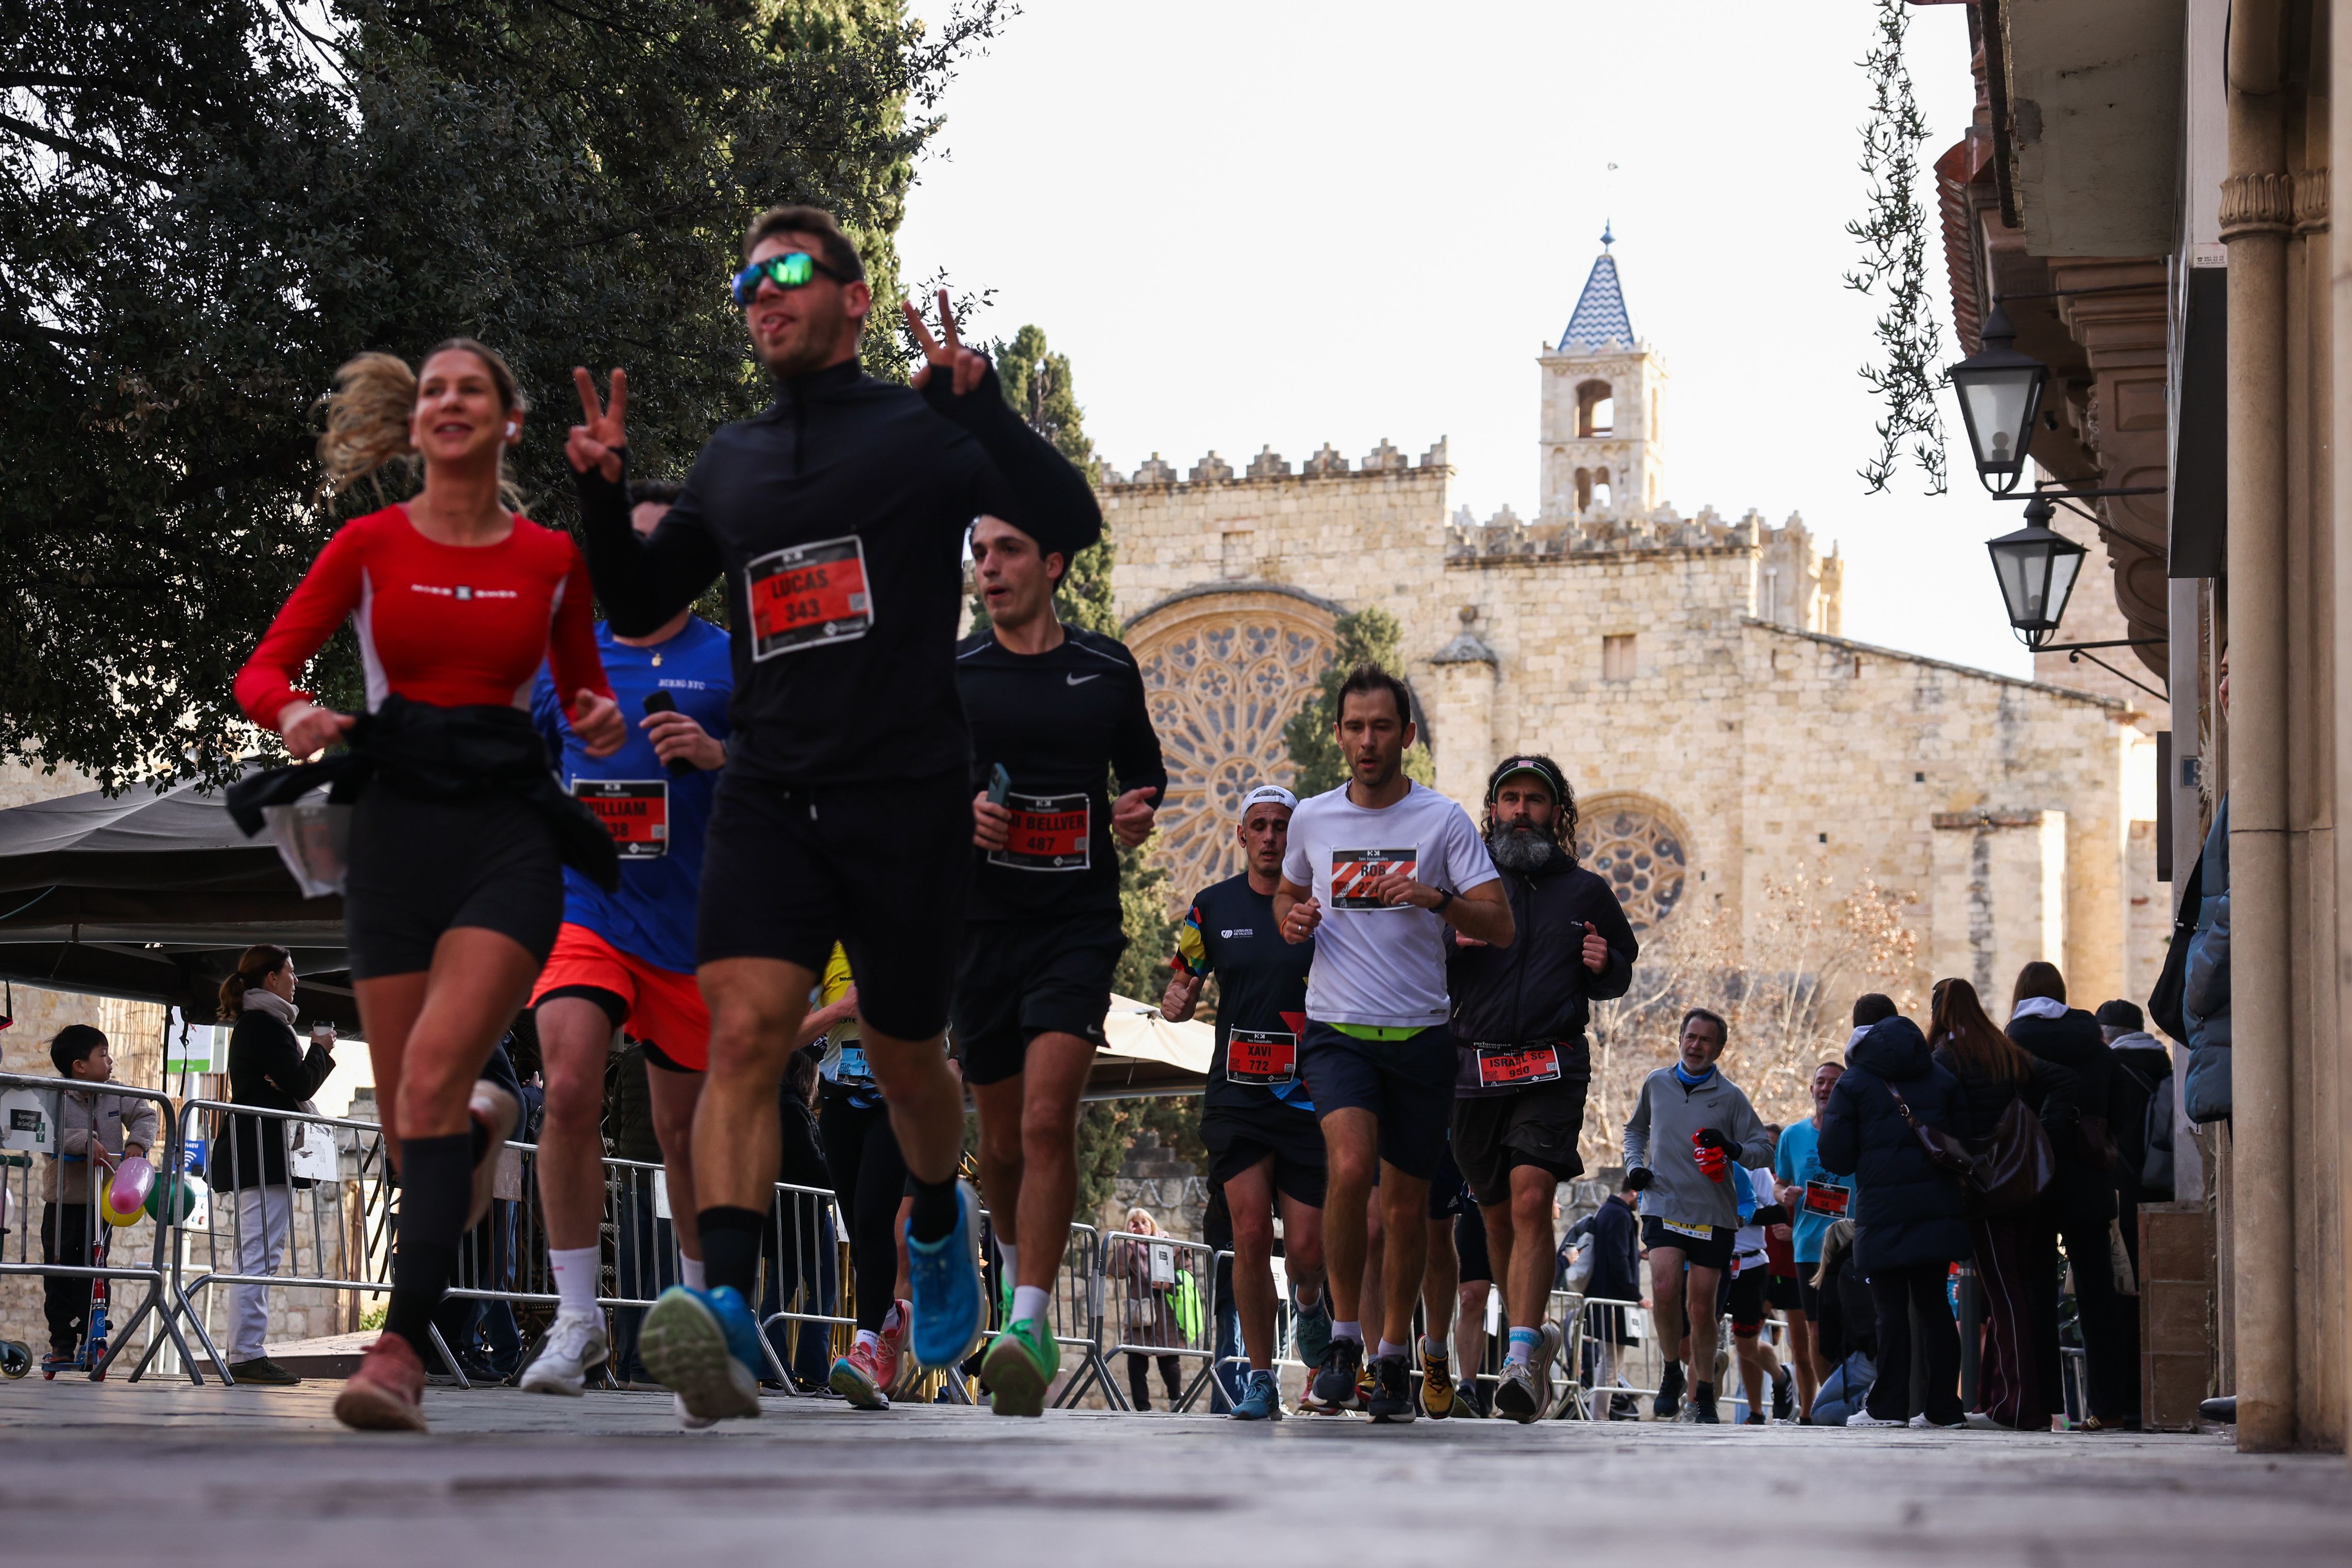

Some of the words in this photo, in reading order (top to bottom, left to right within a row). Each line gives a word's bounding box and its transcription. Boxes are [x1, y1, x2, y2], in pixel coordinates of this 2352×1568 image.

[771, 569, 829, 599] LUCAS
[786, 599, 821, 622] 343
[1027, 814, 1084, 831] BELLVER
[609, 822, 628, 838] 38
[1027, 836, 1055, 851] 487
[1360, 864, 1386, 877] ROB
[1248, 1045, 1271, 1057] XAVI
[1530, 1052, 1545, 1061] SC
[1249, 1060, 1269, 1071] 772
[1509, 1066, 1530, 1078] 950
